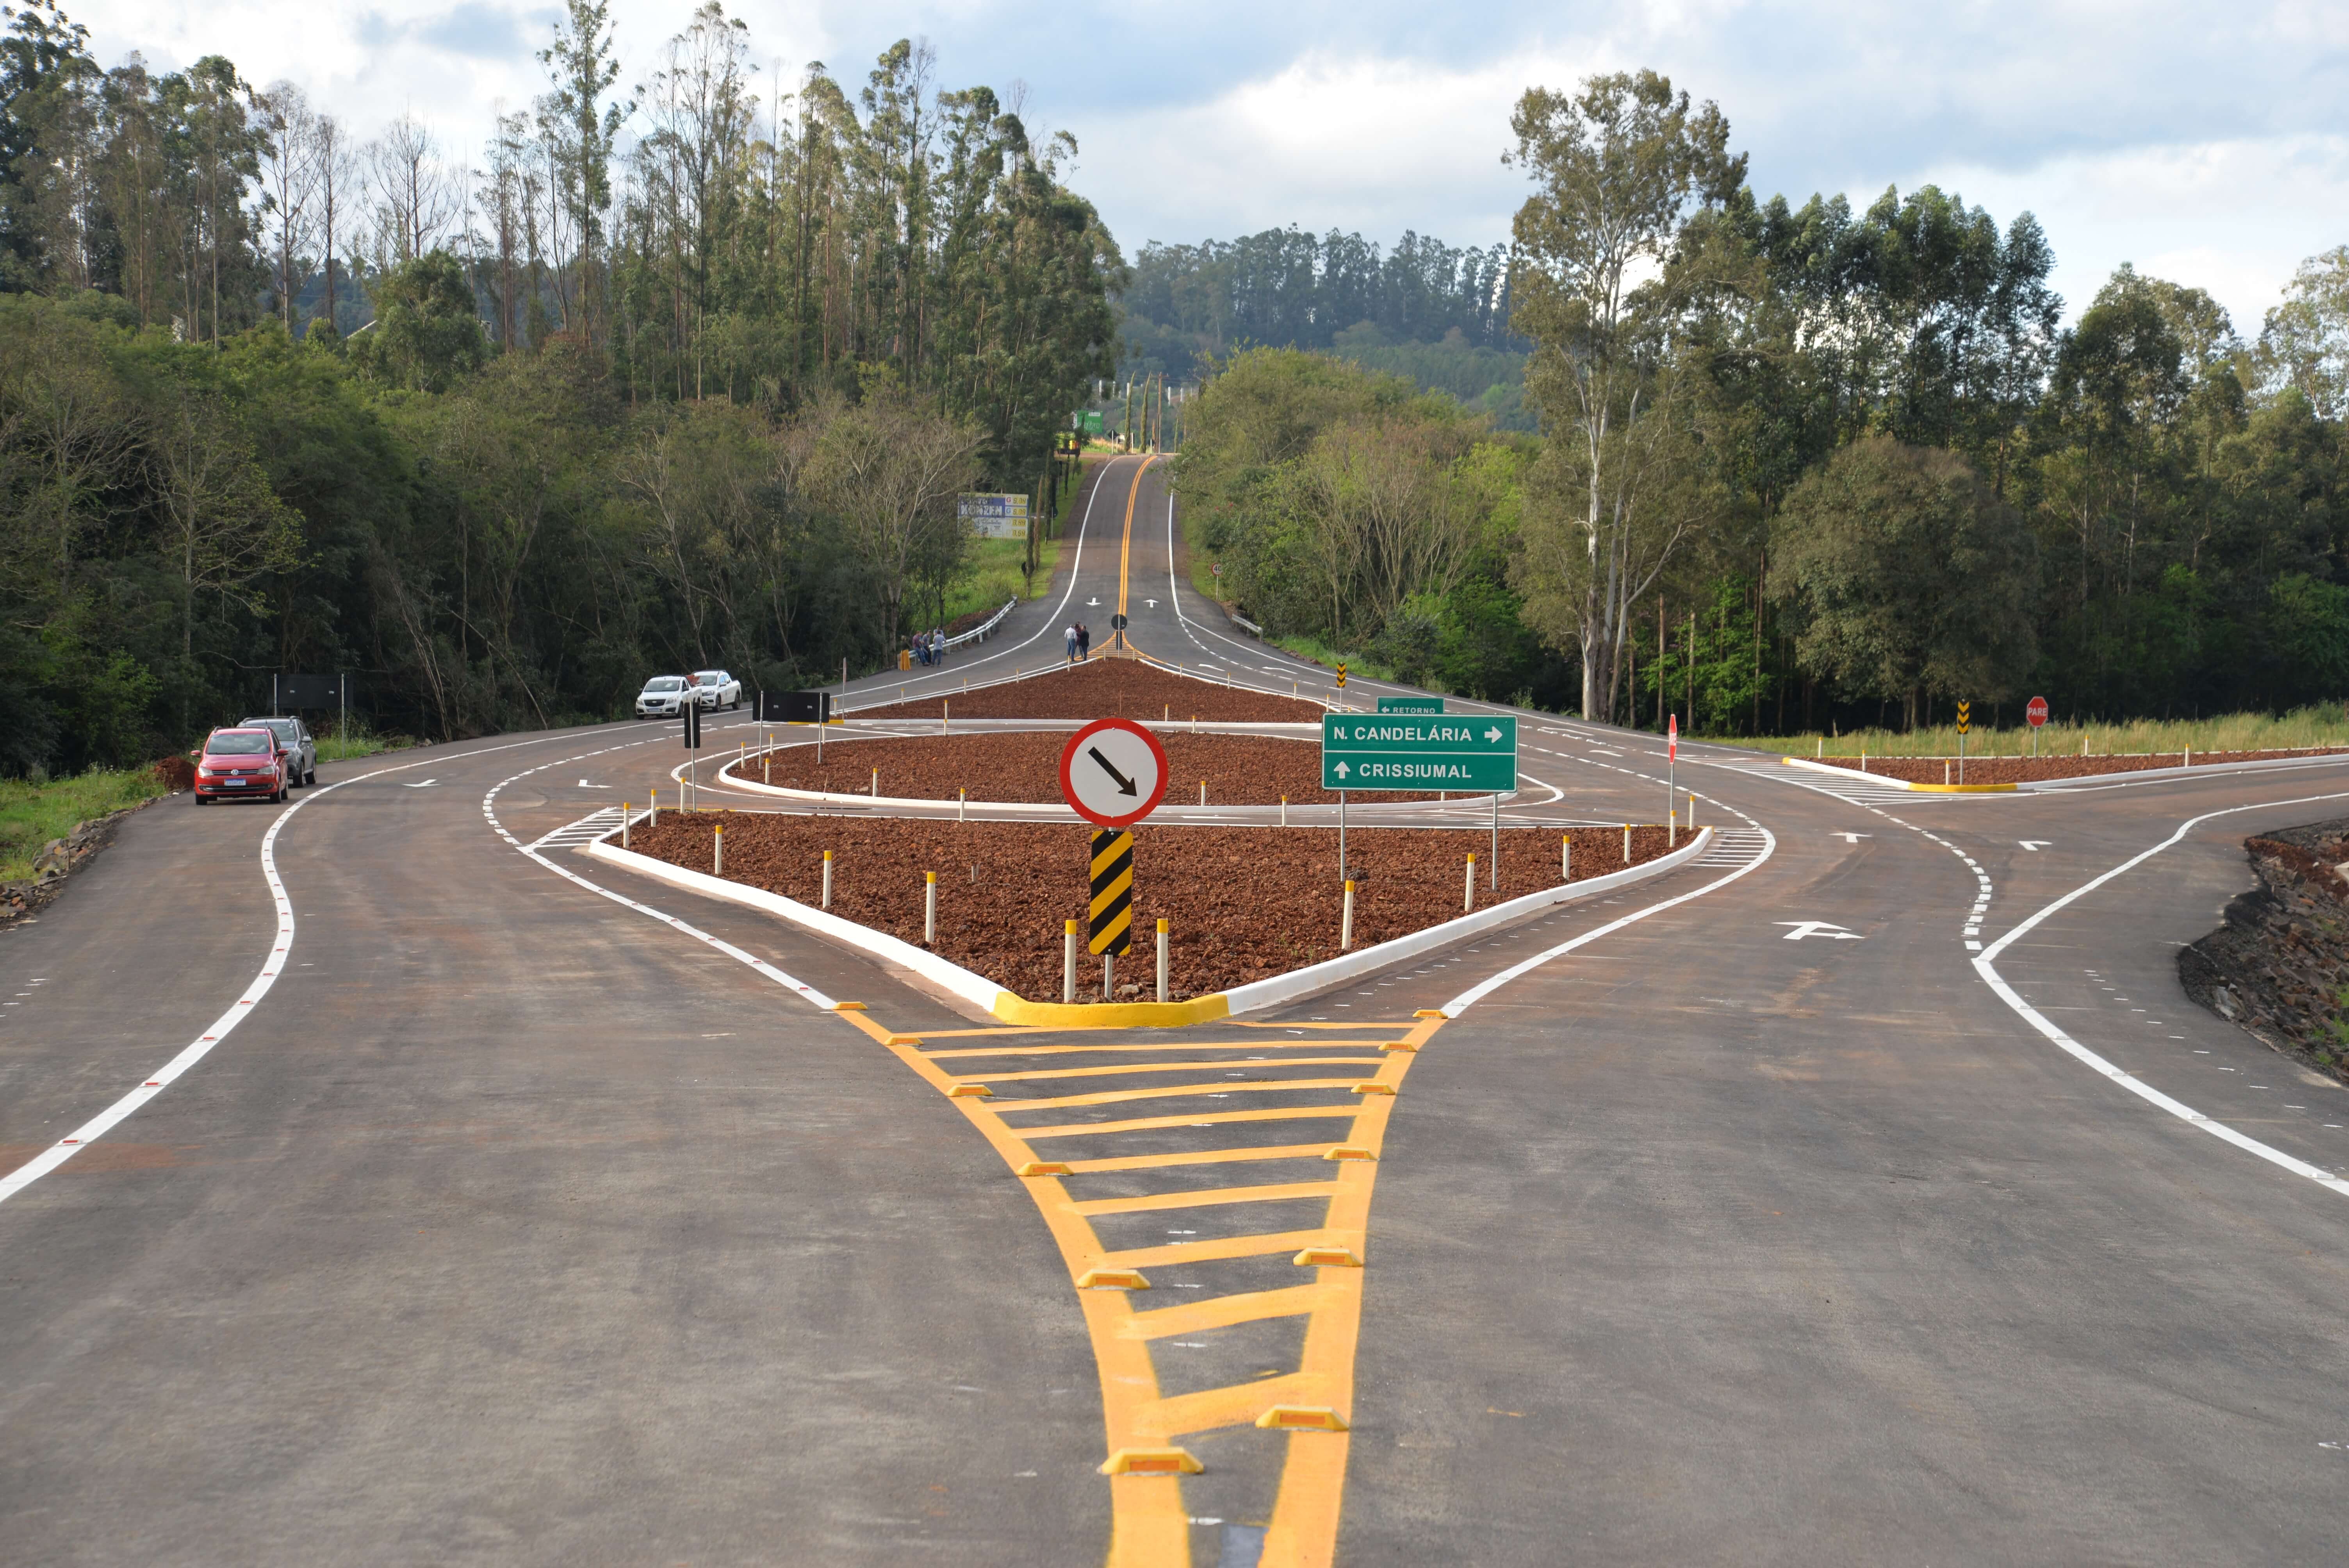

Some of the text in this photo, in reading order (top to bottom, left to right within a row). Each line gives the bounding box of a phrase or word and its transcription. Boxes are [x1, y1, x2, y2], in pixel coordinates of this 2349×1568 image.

[2028, 707, 2047, 716] PARE
[1334, 725, 1472, 741] N. CANDELÁRIA
[1360, 764, 1472, 778] CRISSIUMAL
